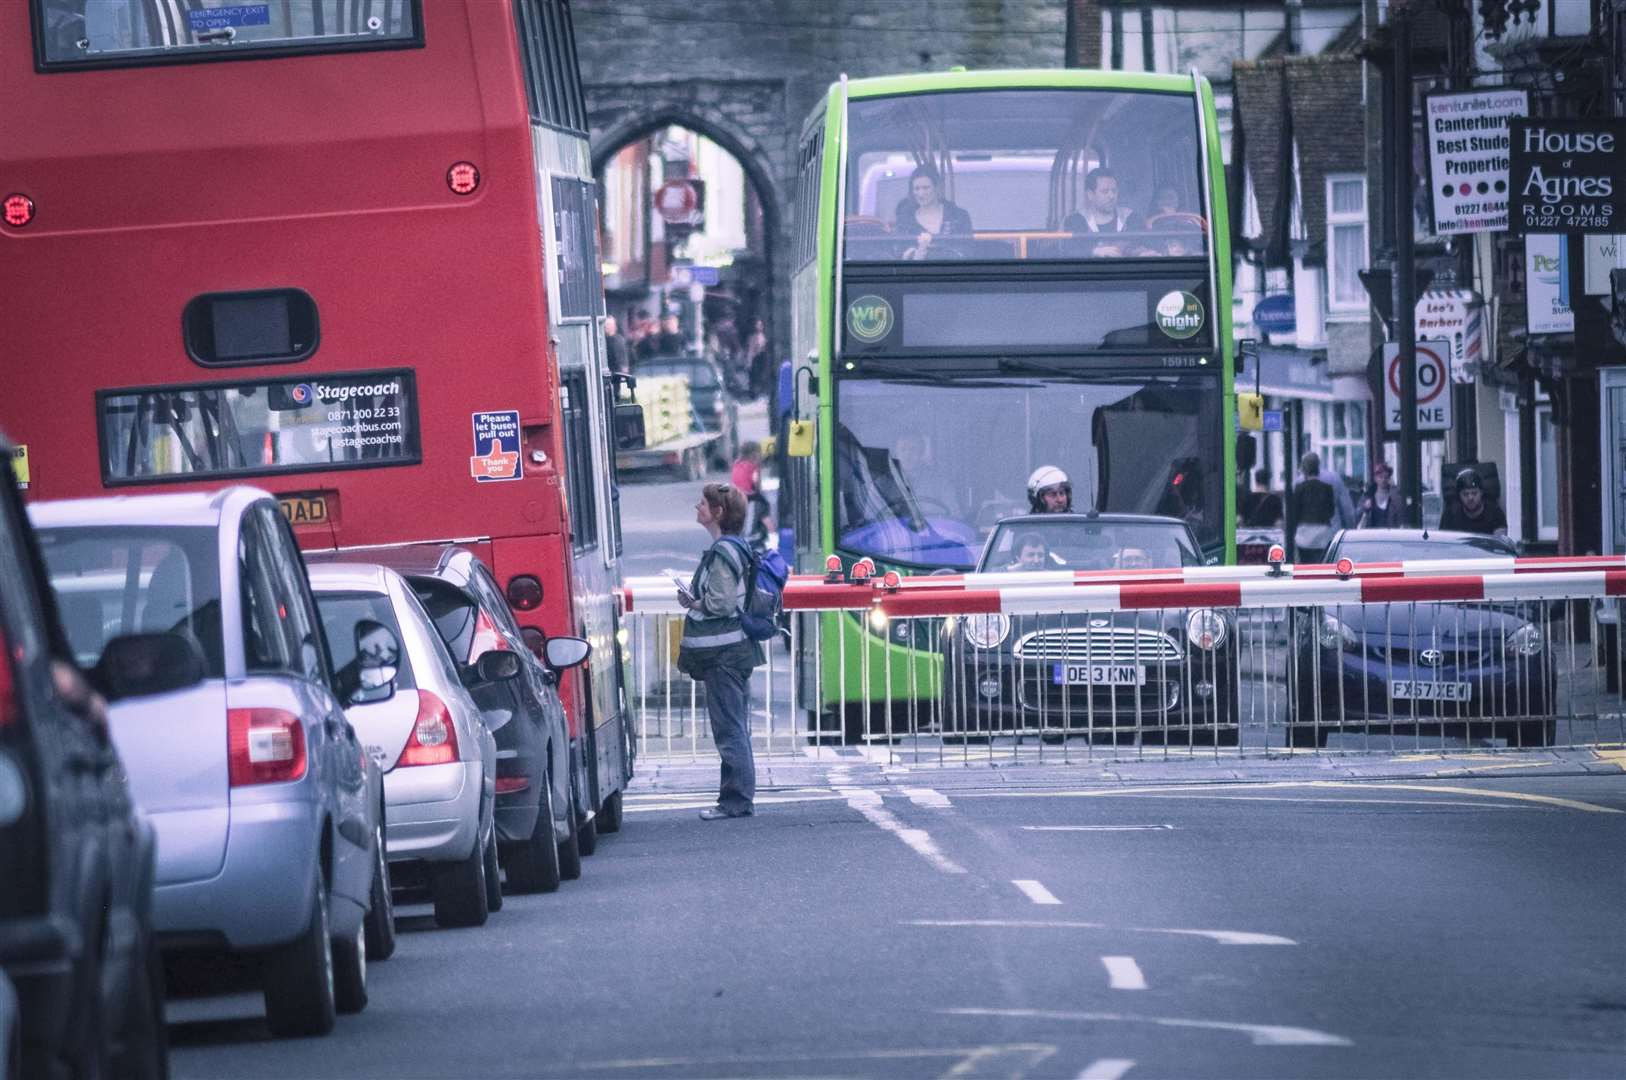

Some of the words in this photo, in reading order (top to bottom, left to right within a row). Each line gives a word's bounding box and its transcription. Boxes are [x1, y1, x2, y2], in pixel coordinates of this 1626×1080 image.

[190, 7, 242, 18] EMERGENCY
[245, 6, 266, 15] EXIT
[192, 20, 204, 28] TO
[206, 18, 231, 28] OPEN
[1437, 139, 1467, 154] Best
[1470, 135, 1509, 151] Stude
[1524, 127, 1615, 153] House
[1446, 156, 1510, 175] Propertie
[1562, 160, 1572, 168] of
[1522, 165, 1613, 204] Agnes
[1455, 204, 1480, 216] 01227
[1523, 204, 1613, 216] ROOMS
[1526, 216, 1560, 226] 01227
[1567, 216, 1609, 227] 472185
[1162, 313, 1200, 330] night
[1420, 318, 1463, 329] Barbers
[316, 381, 400, 401] Stagecoach
[328, 411, 351, 422] 0871
[353, 408, 372, 420] 200
[374, 407, 386, 418] 22
[388, 406, 400, 416] 33
[480, 414, 511, 423] Please
[1392, 408, 1445, 423] ZNE
[311, 420, 402, 438] stagecoachbus.com
[475, 423, 489, 431] let
[491, 422, 517, 430] buses
[479, 430, 496, 441] pull
[499, 430, 515, 438] out
[482, 457, 509, 466] Thank
[488, 465, 503, 473] you
